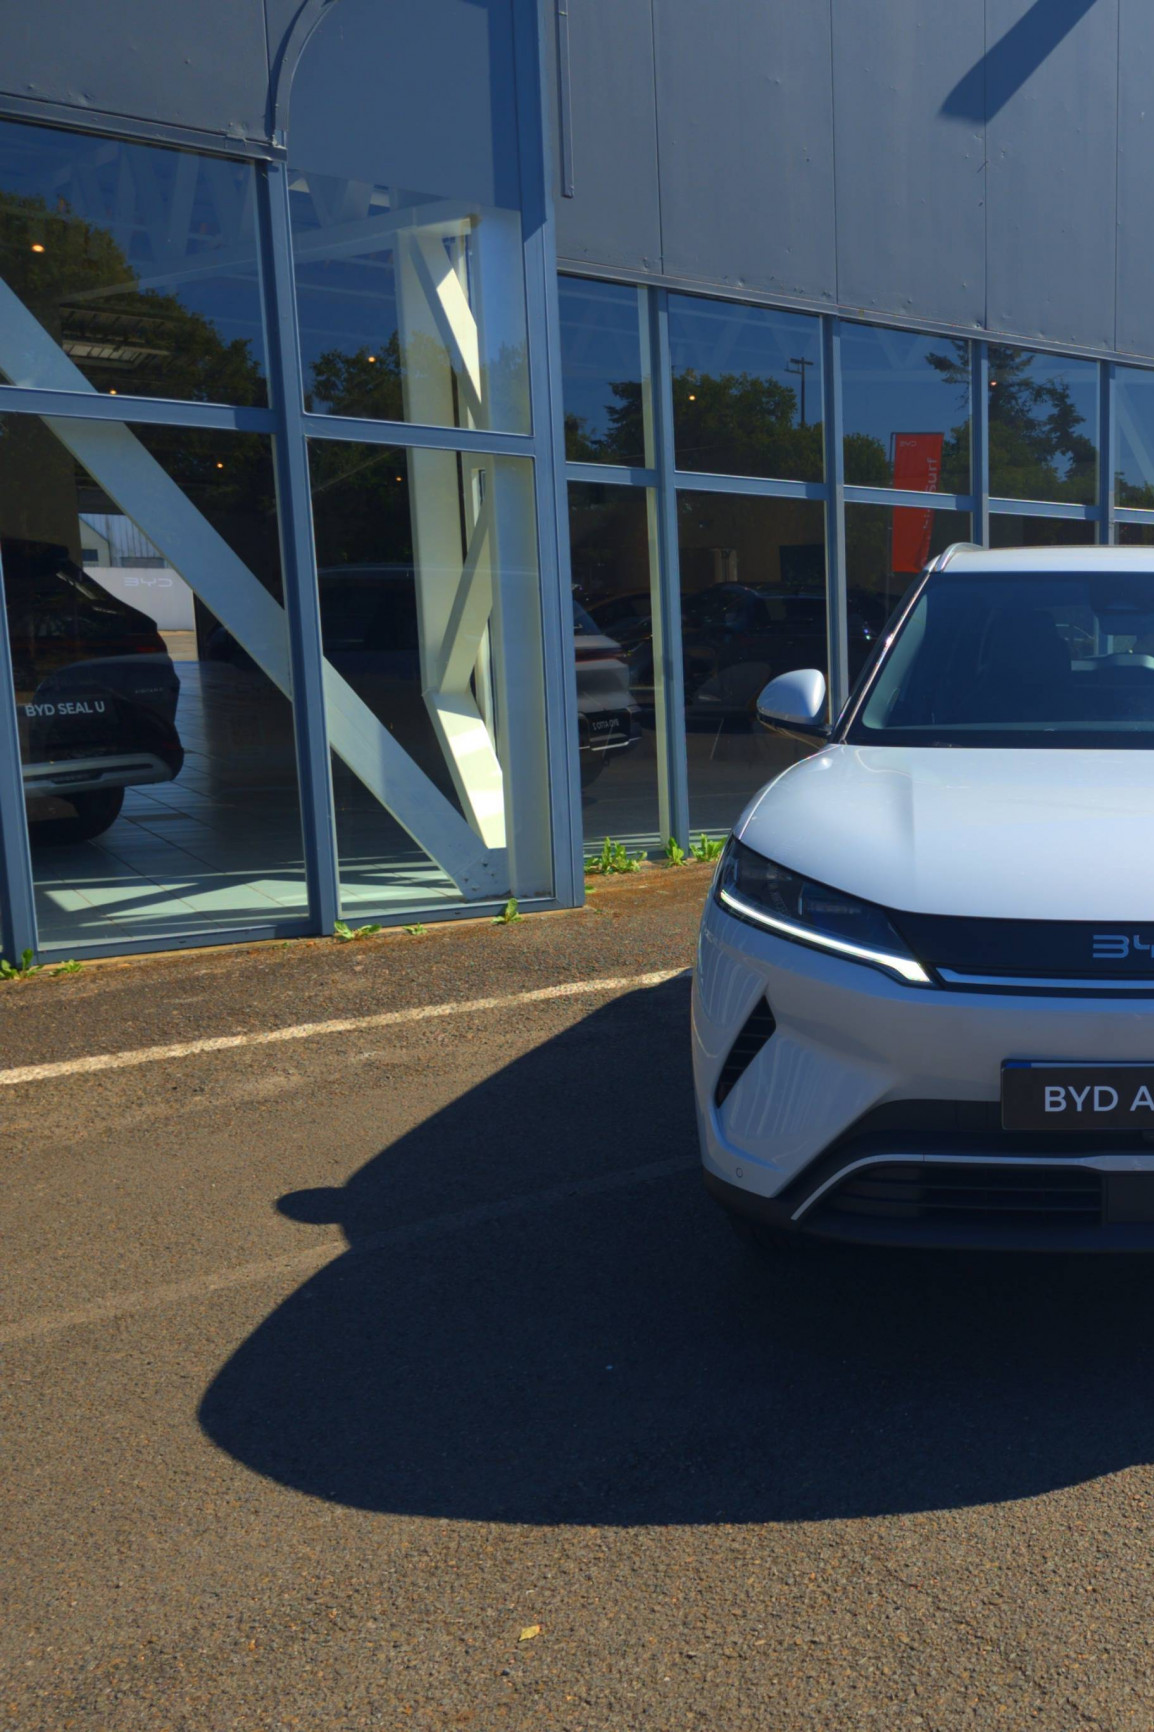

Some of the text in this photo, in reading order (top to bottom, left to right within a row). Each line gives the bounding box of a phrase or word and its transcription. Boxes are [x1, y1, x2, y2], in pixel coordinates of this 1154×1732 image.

[123, 577, 173, 588] BYD
[25, 701, 105, 717] BYD SEAL U
[1044, 1085, 1119, 1112] BYD
